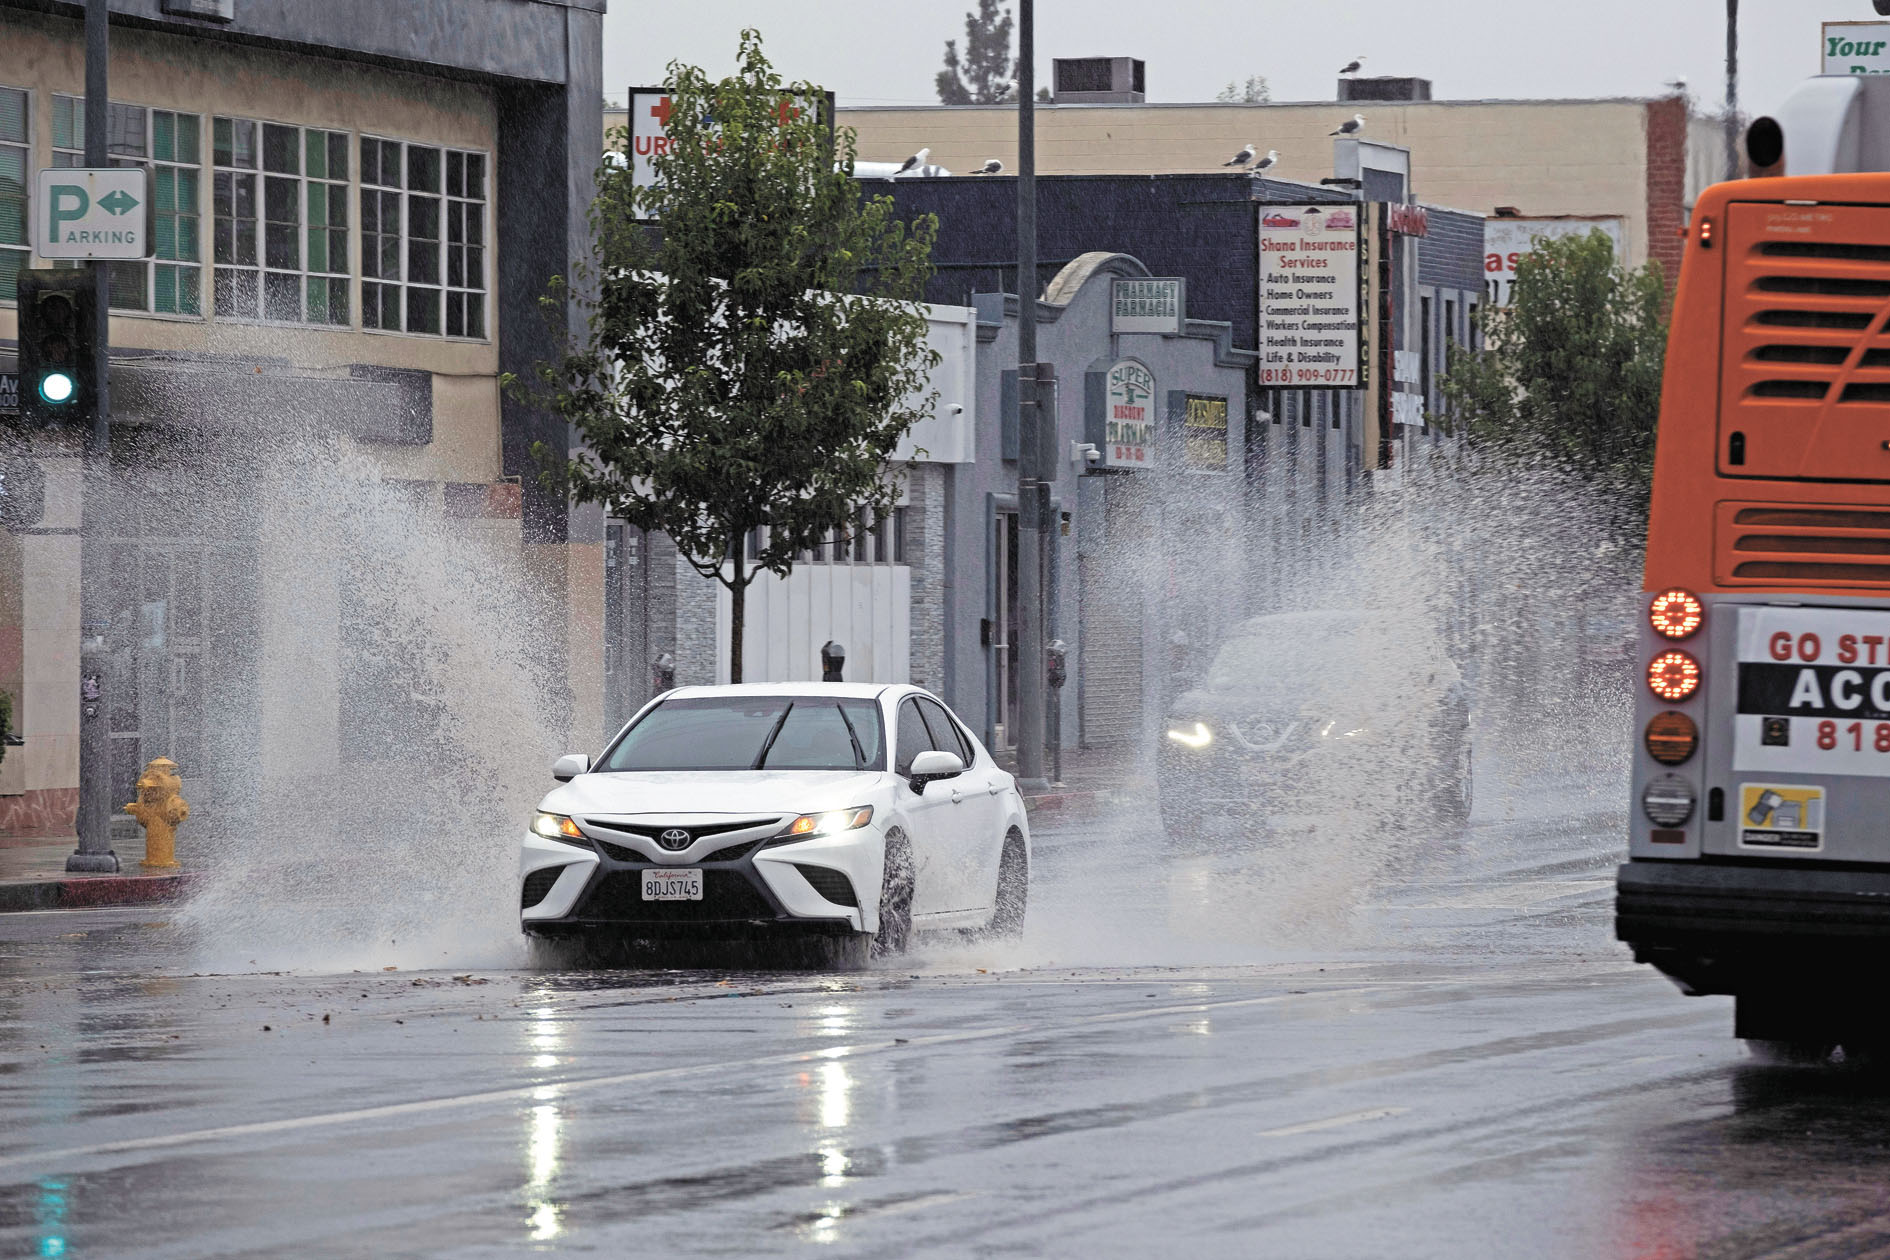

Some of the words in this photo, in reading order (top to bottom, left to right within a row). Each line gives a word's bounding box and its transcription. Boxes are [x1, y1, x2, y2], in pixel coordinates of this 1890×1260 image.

[1826, 37, 1887, 57] Your
[49, 185, 135, 243] PARKING
[1261, 238, 1296, 252] Shana
[1300, 238, 1355, 251] Insurance
[1280, 255, 1328, 268] Services
[1267, 273, 1290, 284] Auto
[1292, 272, 1336, 284] Insurance
[1115, 282, 1176, 299] PHARMACY
[1267, 289, 1293, 300] Home
[1296, 289, 1333, 300] Owners
[1360, 203, 1369, 381] INSURANCE
[1266, 305, 1310, 316] Commercial
[1312, 304, 1349, 316] Insurance
[1266, 320, 1299, 331] Workers
[1301, 320, 1357, 333] Compensation
[1267, 336, 1297, 347] Health
[1300, 336, 1344, 347] Insurance
[1266, 351, 1283, 363] Life
[1286, 352, 1294, 363] &
[1297, 351, 1341, 365] Disability
[1112, 367, 1151, 391] SUPER
[1261, 369, 1293, 383] (818)
[1297, 369, 1355, 381] 909-0777
[0, 375, 19, 393] Av
[0, 393, 19, 407] 00
[1769, 631, 1821, 662] GO
[1837, 634, 1890, 665] ST
[1817, 720, 1890, 752] 818
[646, 881, 699, 896] 8DJS745
